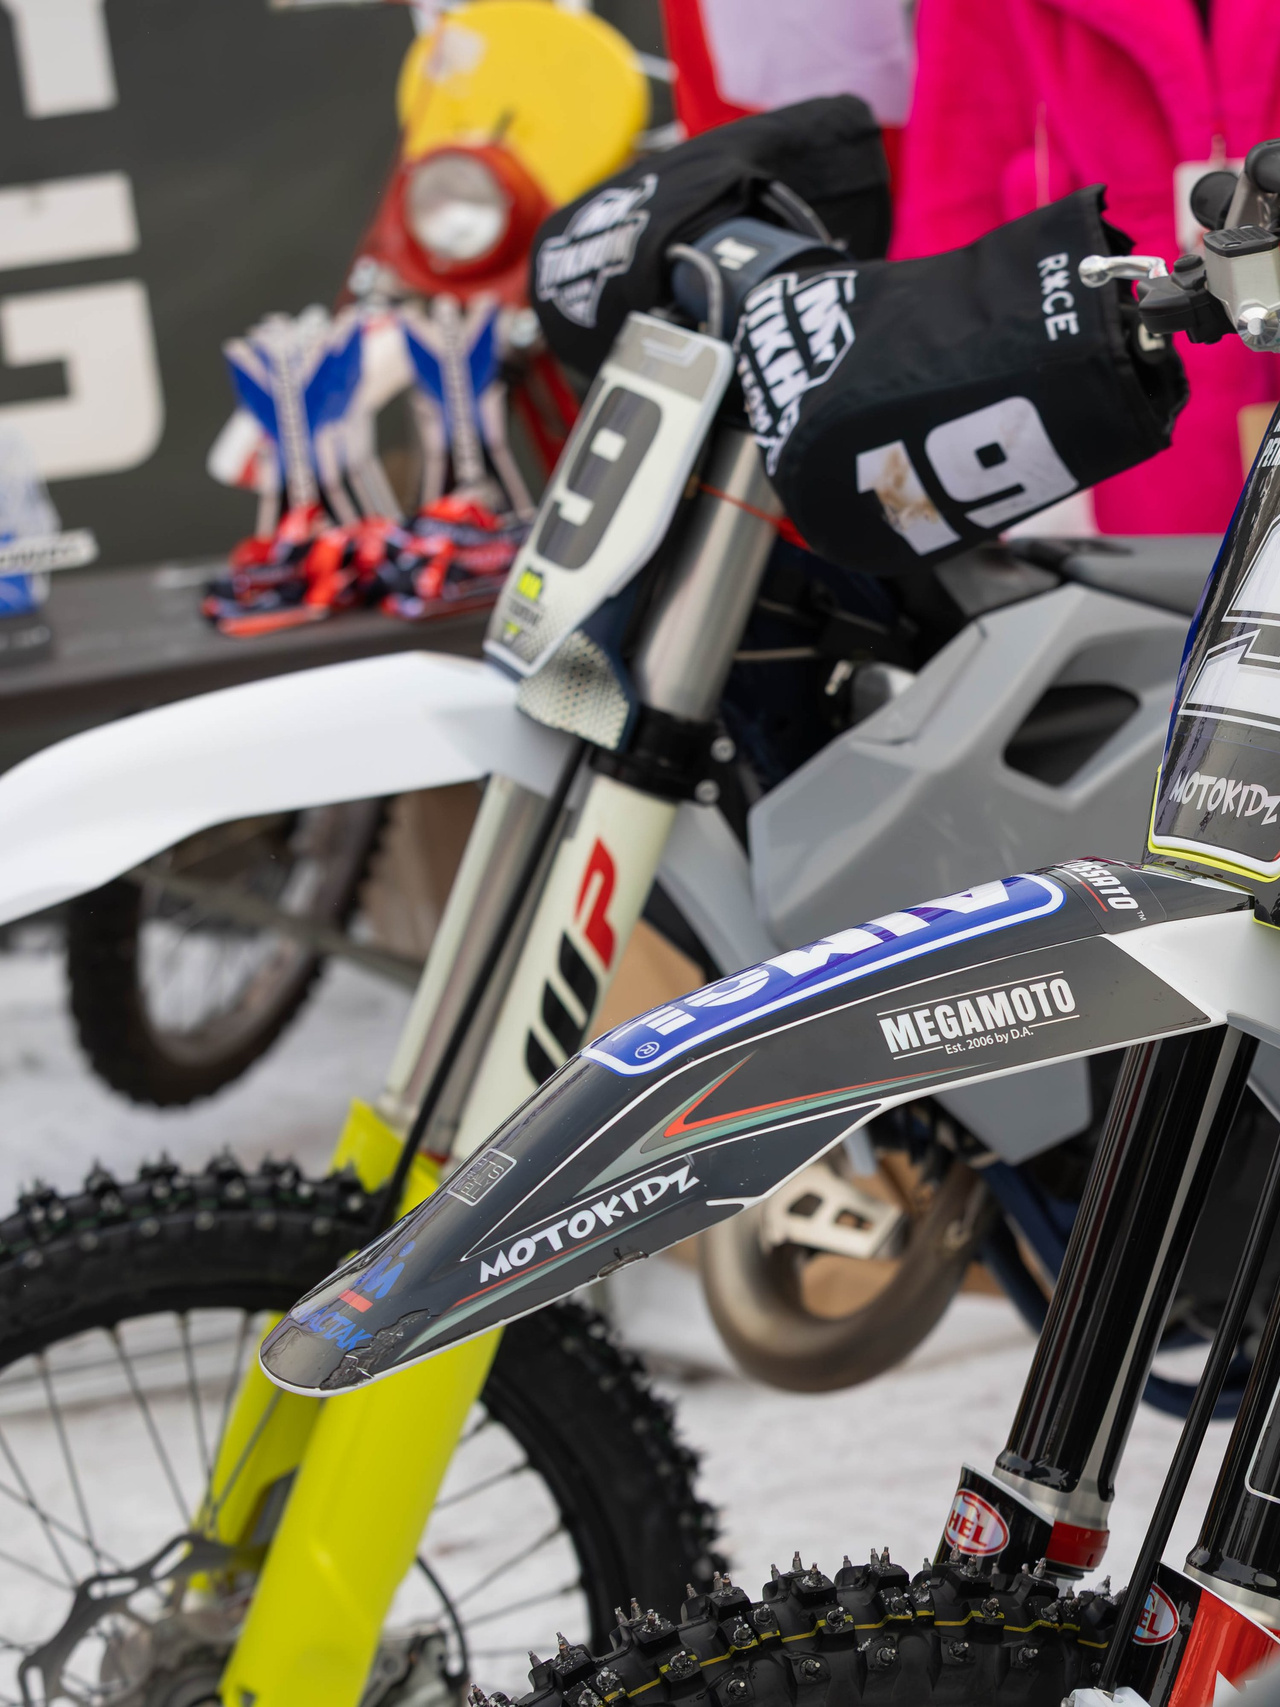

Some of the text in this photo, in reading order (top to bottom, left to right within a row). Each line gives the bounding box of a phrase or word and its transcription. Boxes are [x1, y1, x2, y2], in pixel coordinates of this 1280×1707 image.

[855, 395, 1079, 557] 19
[879, 978, 1076, 1054] MEGAMOTO
[945, 1026, 1034, 1055] Est. 2006 by D.A.
[480, 1164, 701, 1284] MOTOKIDZ
[948, 1508, 988, 1548] HEL
[1137, 1610, 1160, 1637] EL
